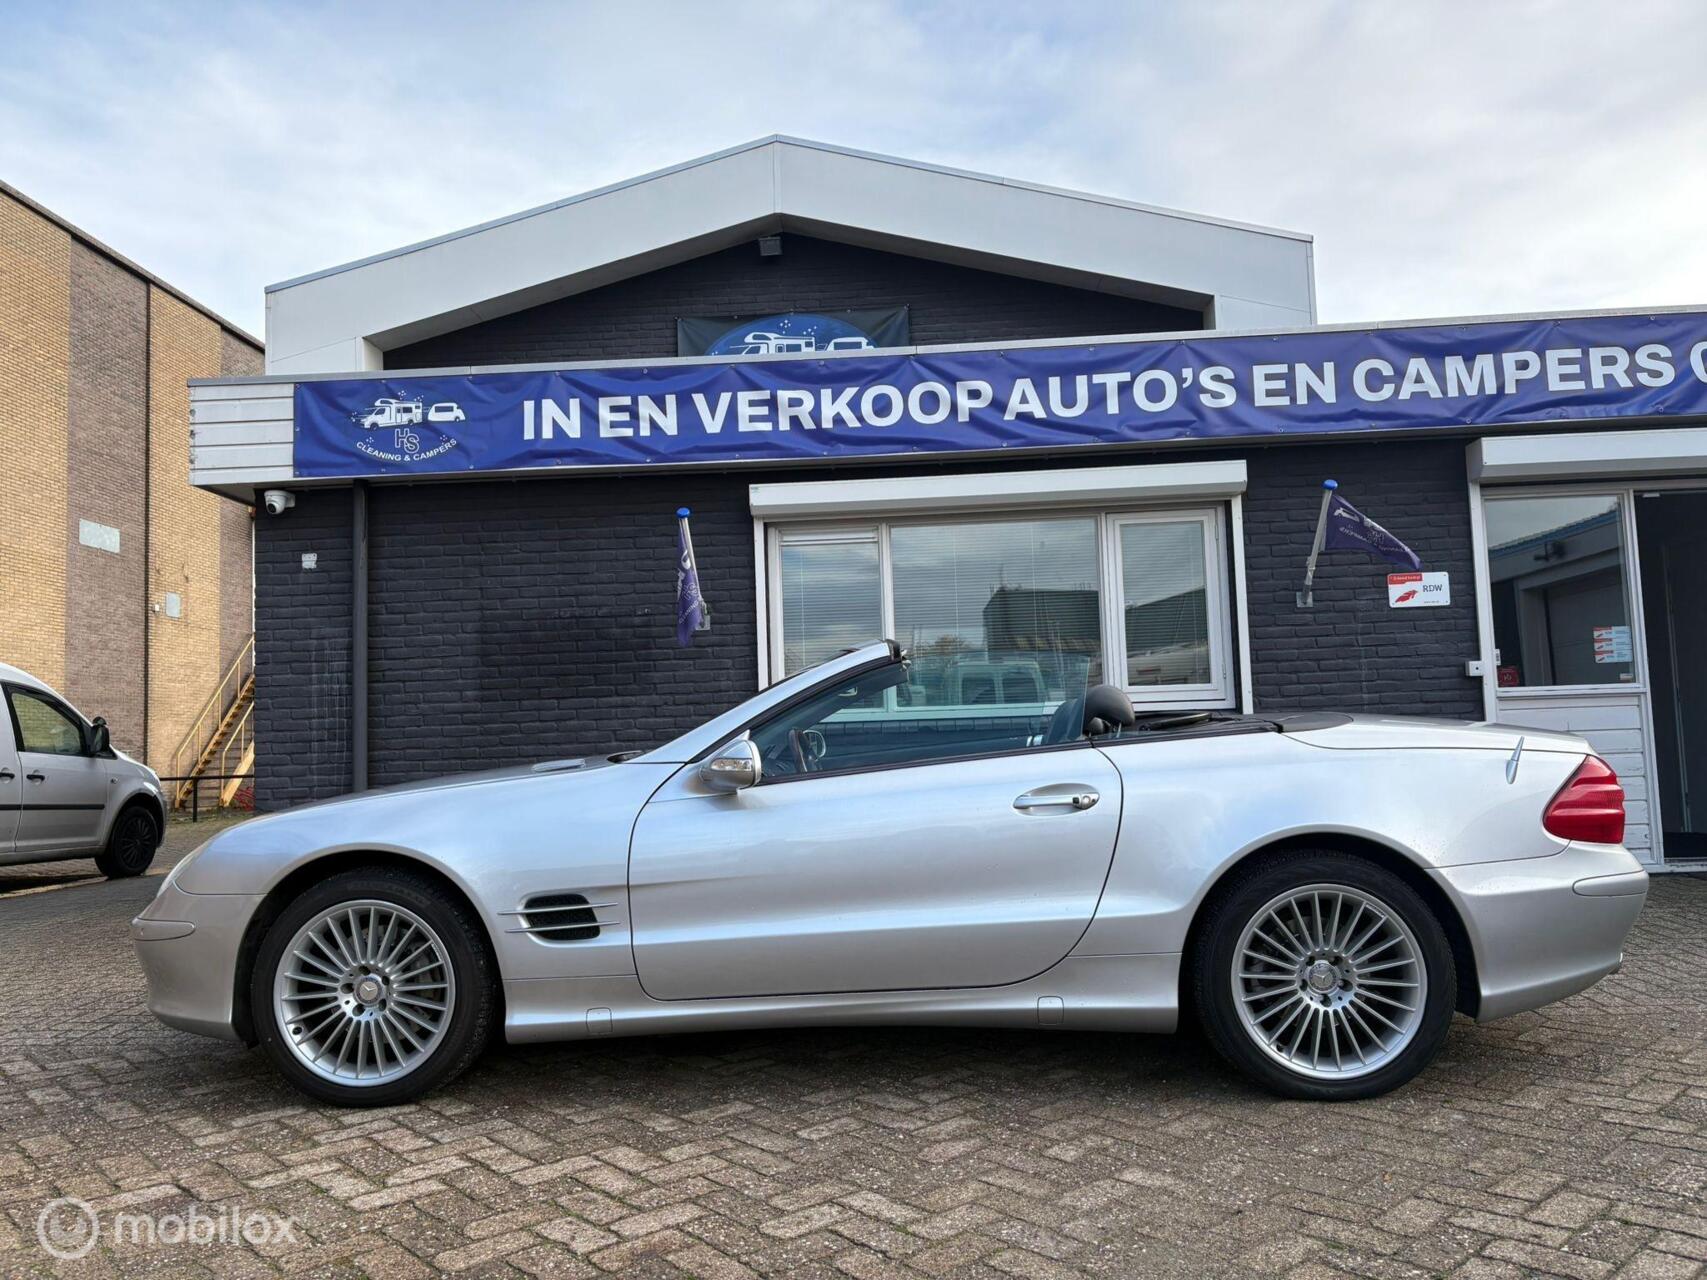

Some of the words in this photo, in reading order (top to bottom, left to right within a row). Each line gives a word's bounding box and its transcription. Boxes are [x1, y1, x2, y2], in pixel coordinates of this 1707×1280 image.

[523, 398, 581, 440] IN
[598, 395, 678, 438] EN
[691, 380, 993, 434] VERKOOP
[1003, 366, 1237, 421] AUTO'S
[1252, 361, 1337, 407] EN
[1352, 344, 1676, 402] CAMPERS
[356, 441, 402, 462] CLEANING
[403, 453, 411, 462] &
[413, 438, 458, 461] CAMPERS
[394, 428, 420, 454] HS
[1422, 584, 1443, 593] RDW
